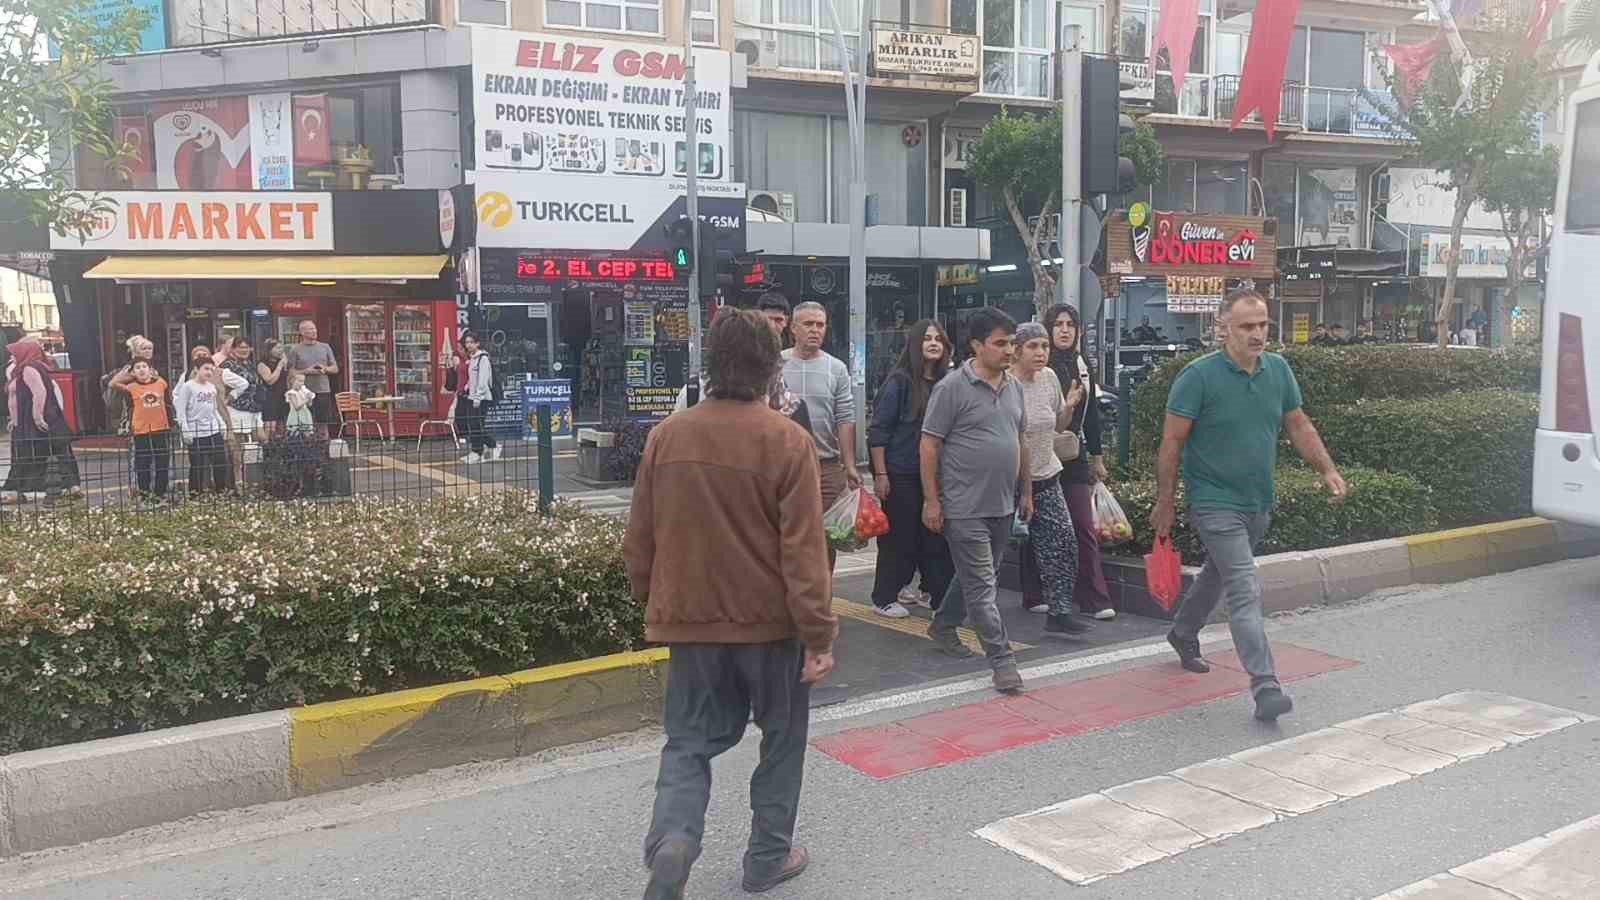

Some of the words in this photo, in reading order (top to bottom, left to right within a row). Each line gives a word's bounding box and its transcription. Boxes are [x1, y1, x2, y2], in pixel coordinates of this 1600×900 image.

[890, 32, 943, 46] ARIKAN
[613, 49, 688, 81] GSM
[484, 74, 537, 97] EKRAN
[623, 89, 671, 107] EKRAN
[495, 103, 604, 128] PROFESYONEL
[127, 202, 320, 241] MARKET
[516, 200, 634, 224] TURKCELL
[710, 215, 739, 228] GSM
[1181, 221, 1216, 240] Güven
[567, 261, 592, 276] EL
[597, 261, 636, 278] CEP
[524, 385, 572, 395] TURKCELL
